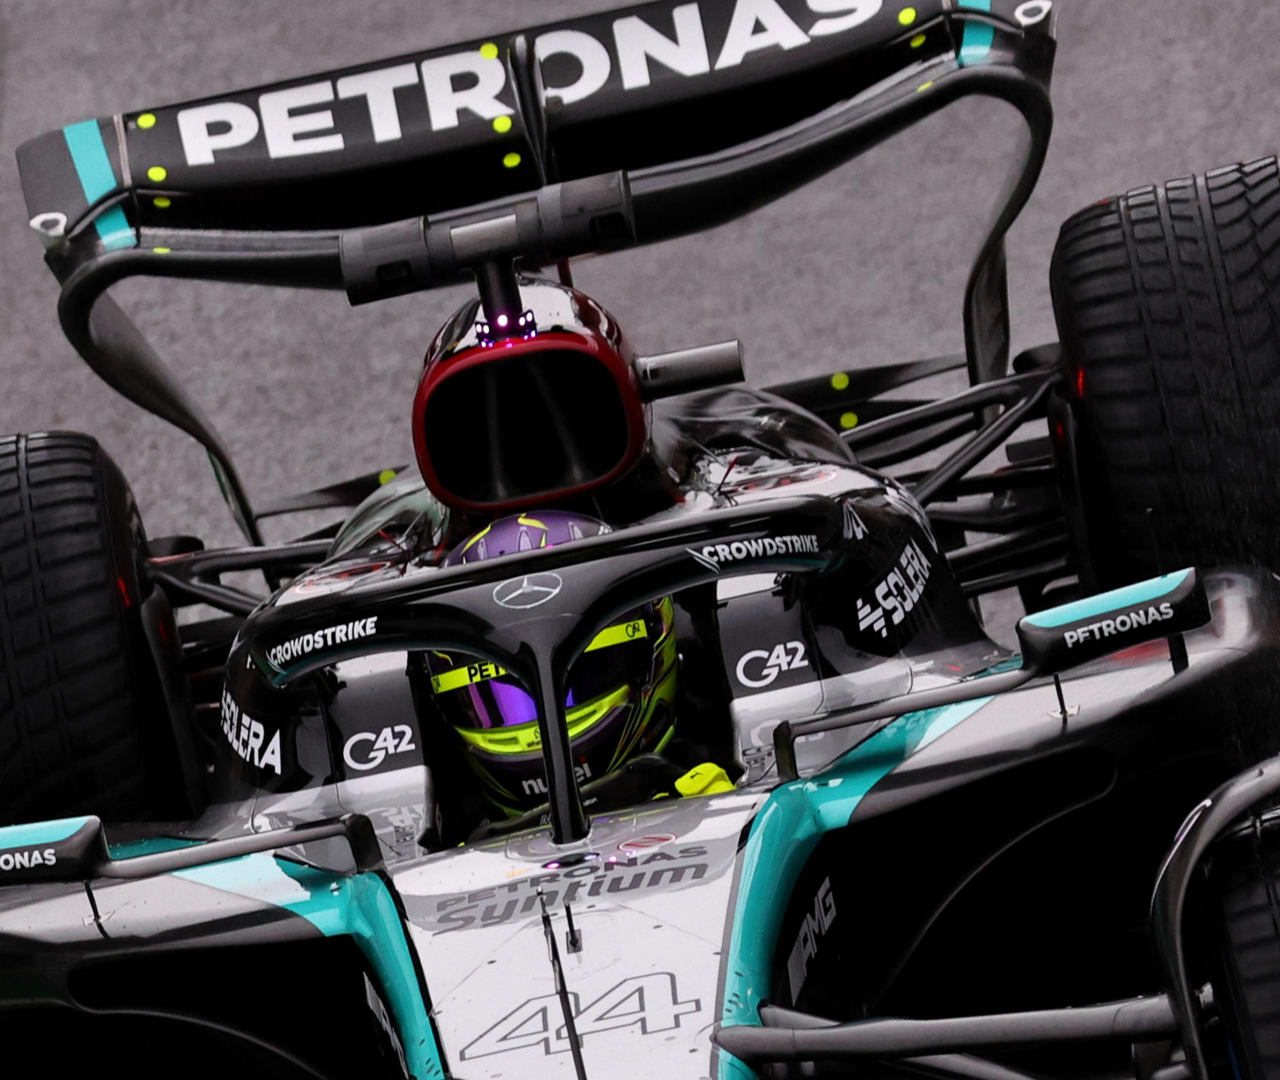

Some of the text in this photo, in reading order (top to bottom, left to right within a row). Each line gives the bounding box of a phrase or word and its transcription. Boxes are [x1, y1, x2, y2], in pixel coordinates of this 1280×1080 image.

[177, 0, 884, 166] PETRONAS
[702, 534, 820, 563] CROWDSTRIKE
[875, 537, 933, 625] SOLERA
[270, 616, 378, 666] CROWDSTRIKE
[1063, 601, 1175, 648] PETRONAS
[736, 640, 810, 688] G42
[223, 690, 281, 775] SOLERA
[343, 724, 416, 770] G42
[522, 757, 592, 795] nuei
[432, 863, 709, 936] Syntium
[437, 846, 708, 911] PETRONAS
[460, 971, 702, 1062] 44
